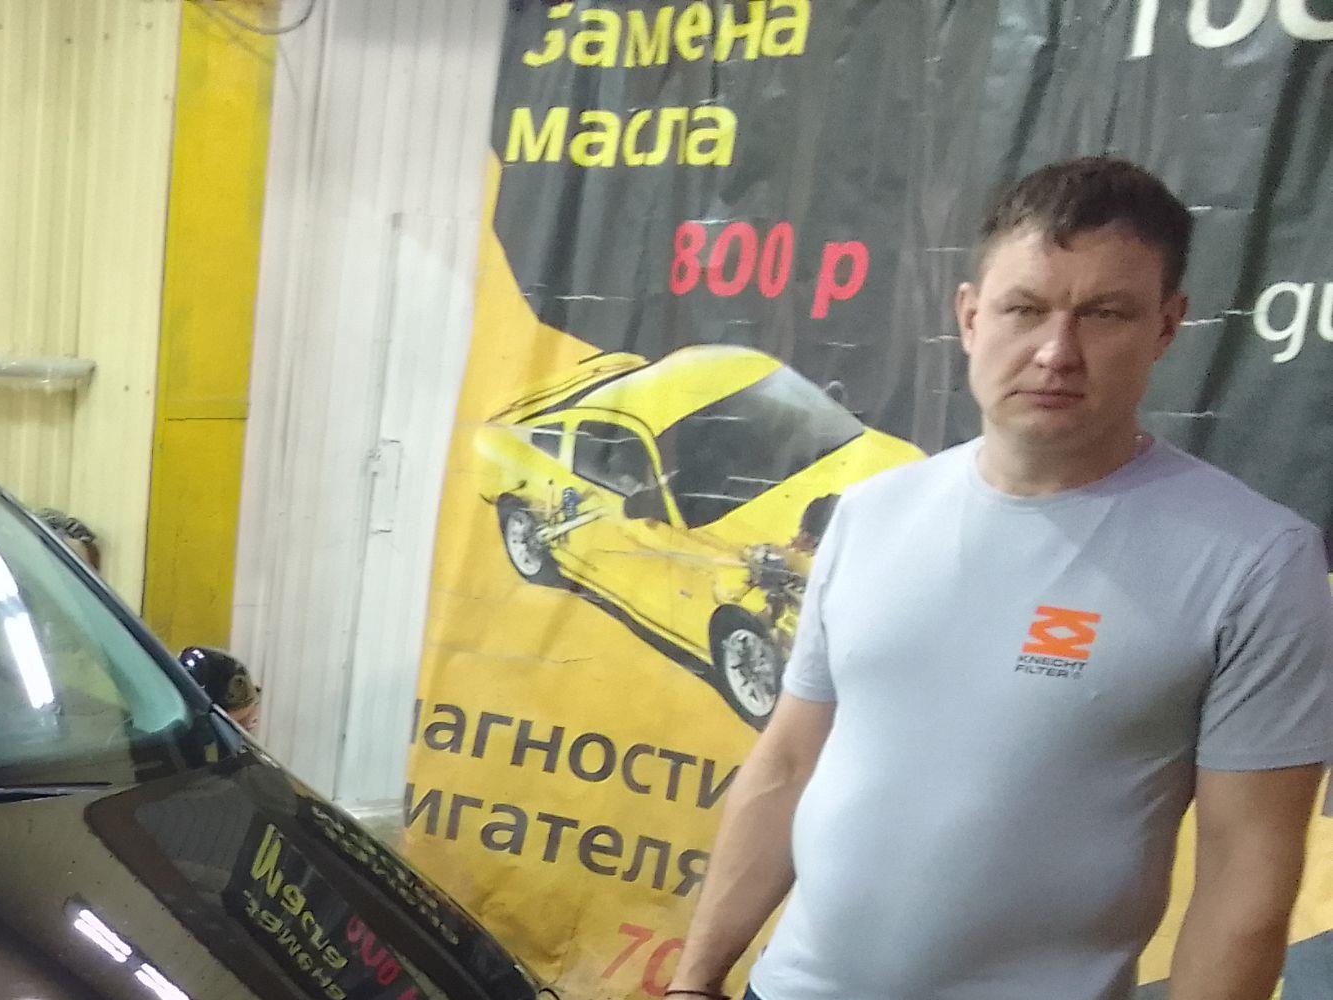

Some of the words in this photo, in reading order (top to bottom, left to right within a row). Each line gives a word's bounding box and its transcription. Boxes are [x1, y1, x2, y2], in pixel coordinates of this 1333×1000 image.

[505, 106, 738, 167] масла
[669, 221, 795, 298] 800
[1017, 655, 1087, 671] KNECHT
